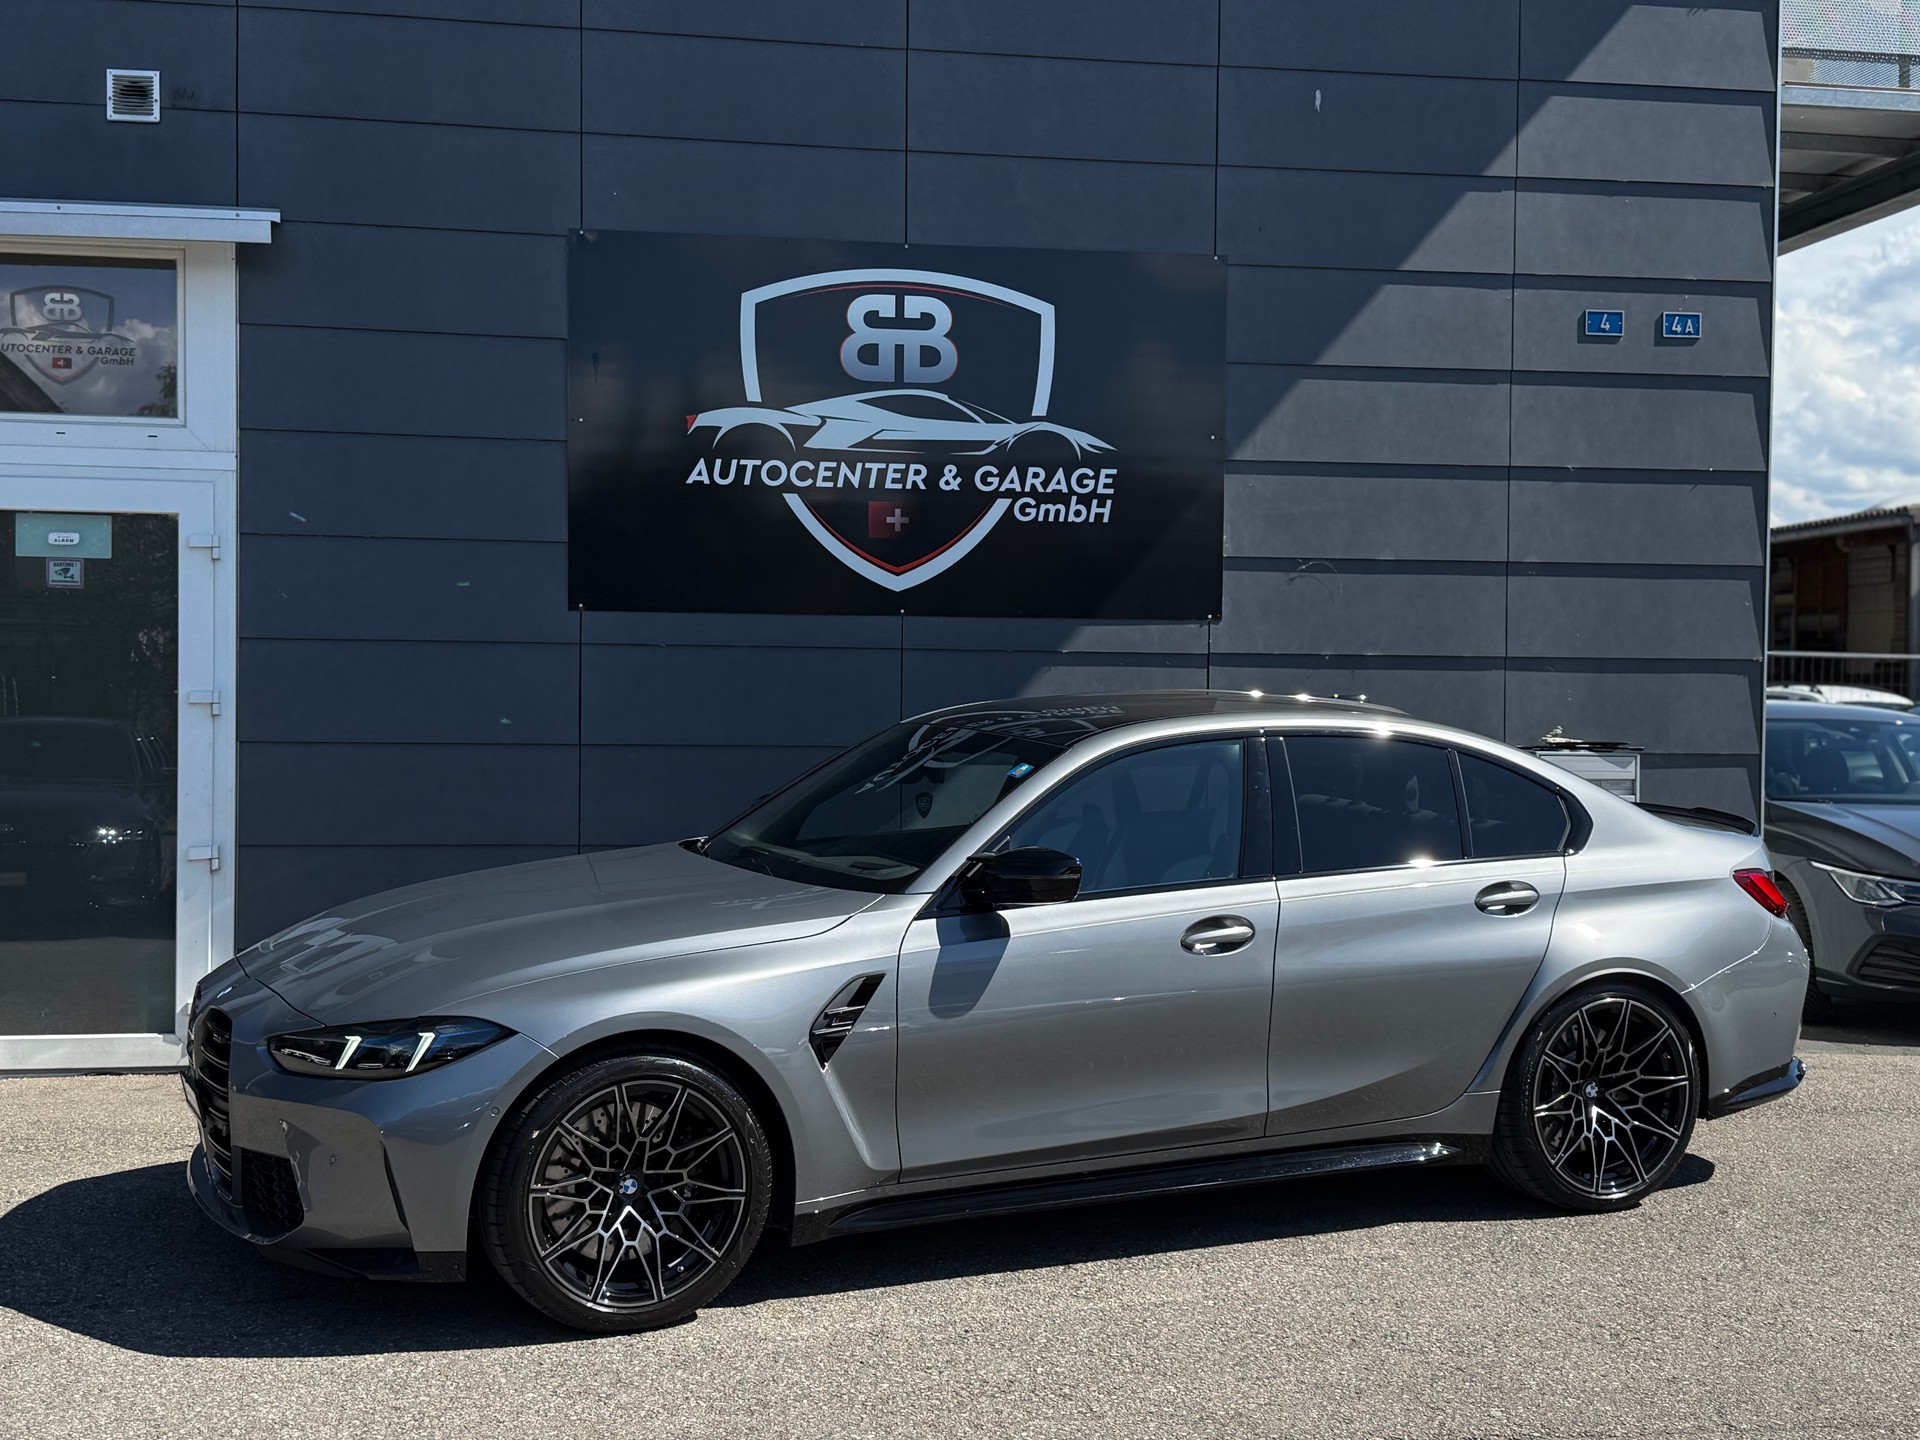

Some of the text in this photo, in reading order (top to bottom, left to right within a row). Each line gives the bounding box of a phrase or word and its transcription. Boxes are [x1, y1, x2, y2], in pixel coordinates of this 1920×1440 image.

[1600, 314, 1610, 331] 4
[1671, 316, 1694, 334] 4A
[0, 343, 136, 357] UTOCENTER & GARAGE
[101, 356, 135, 366] GmbH
[686, 458, 1118, 495] AUTOCENTER & GARAGE
[1012, 494, 1112, 524] GmbH
